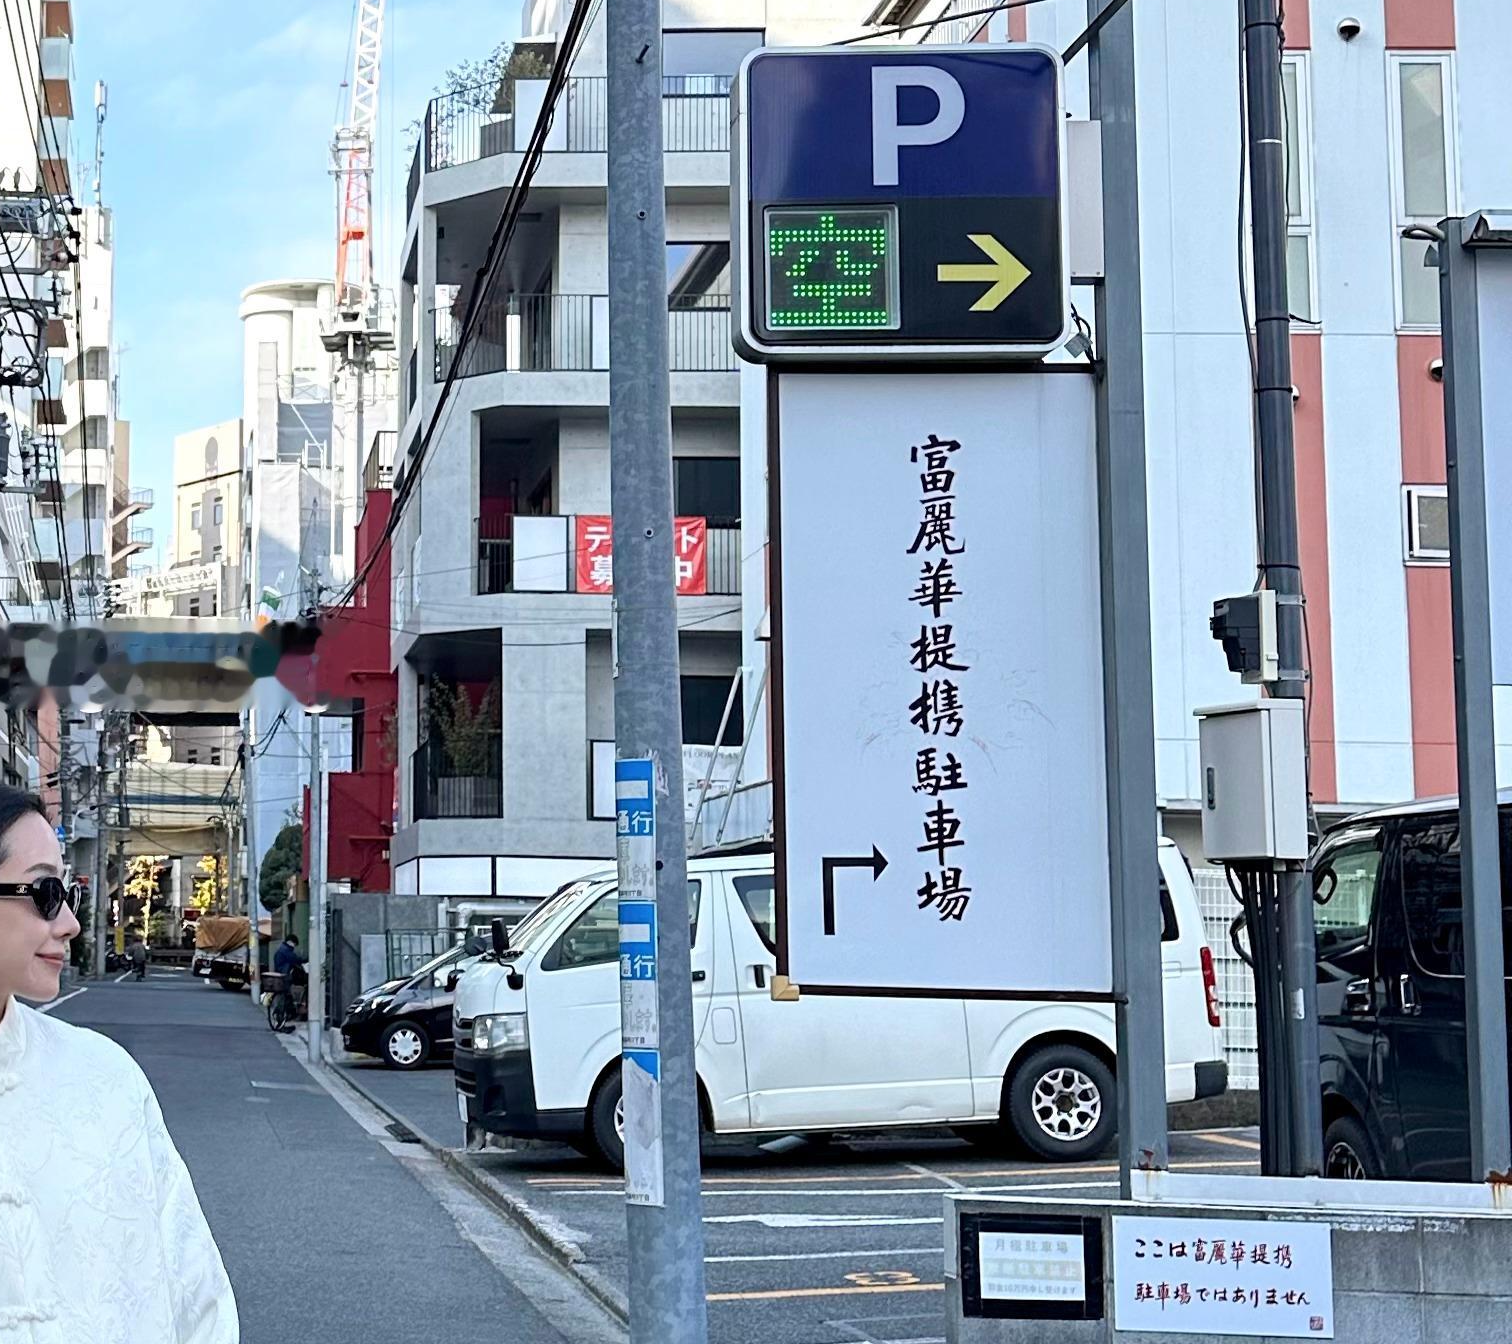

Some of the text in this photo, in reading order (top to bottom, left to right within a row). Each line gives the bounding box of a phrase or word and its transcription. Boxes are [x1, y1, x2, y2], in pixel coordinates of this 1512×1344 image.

[872, 65, 965, 185] P
[770, 215, 886, 324] 空
[906, 434, 971, 922] 富麗華提携駐車場
[1134, 1281, 1311, 1311] 駐車場ではありません
